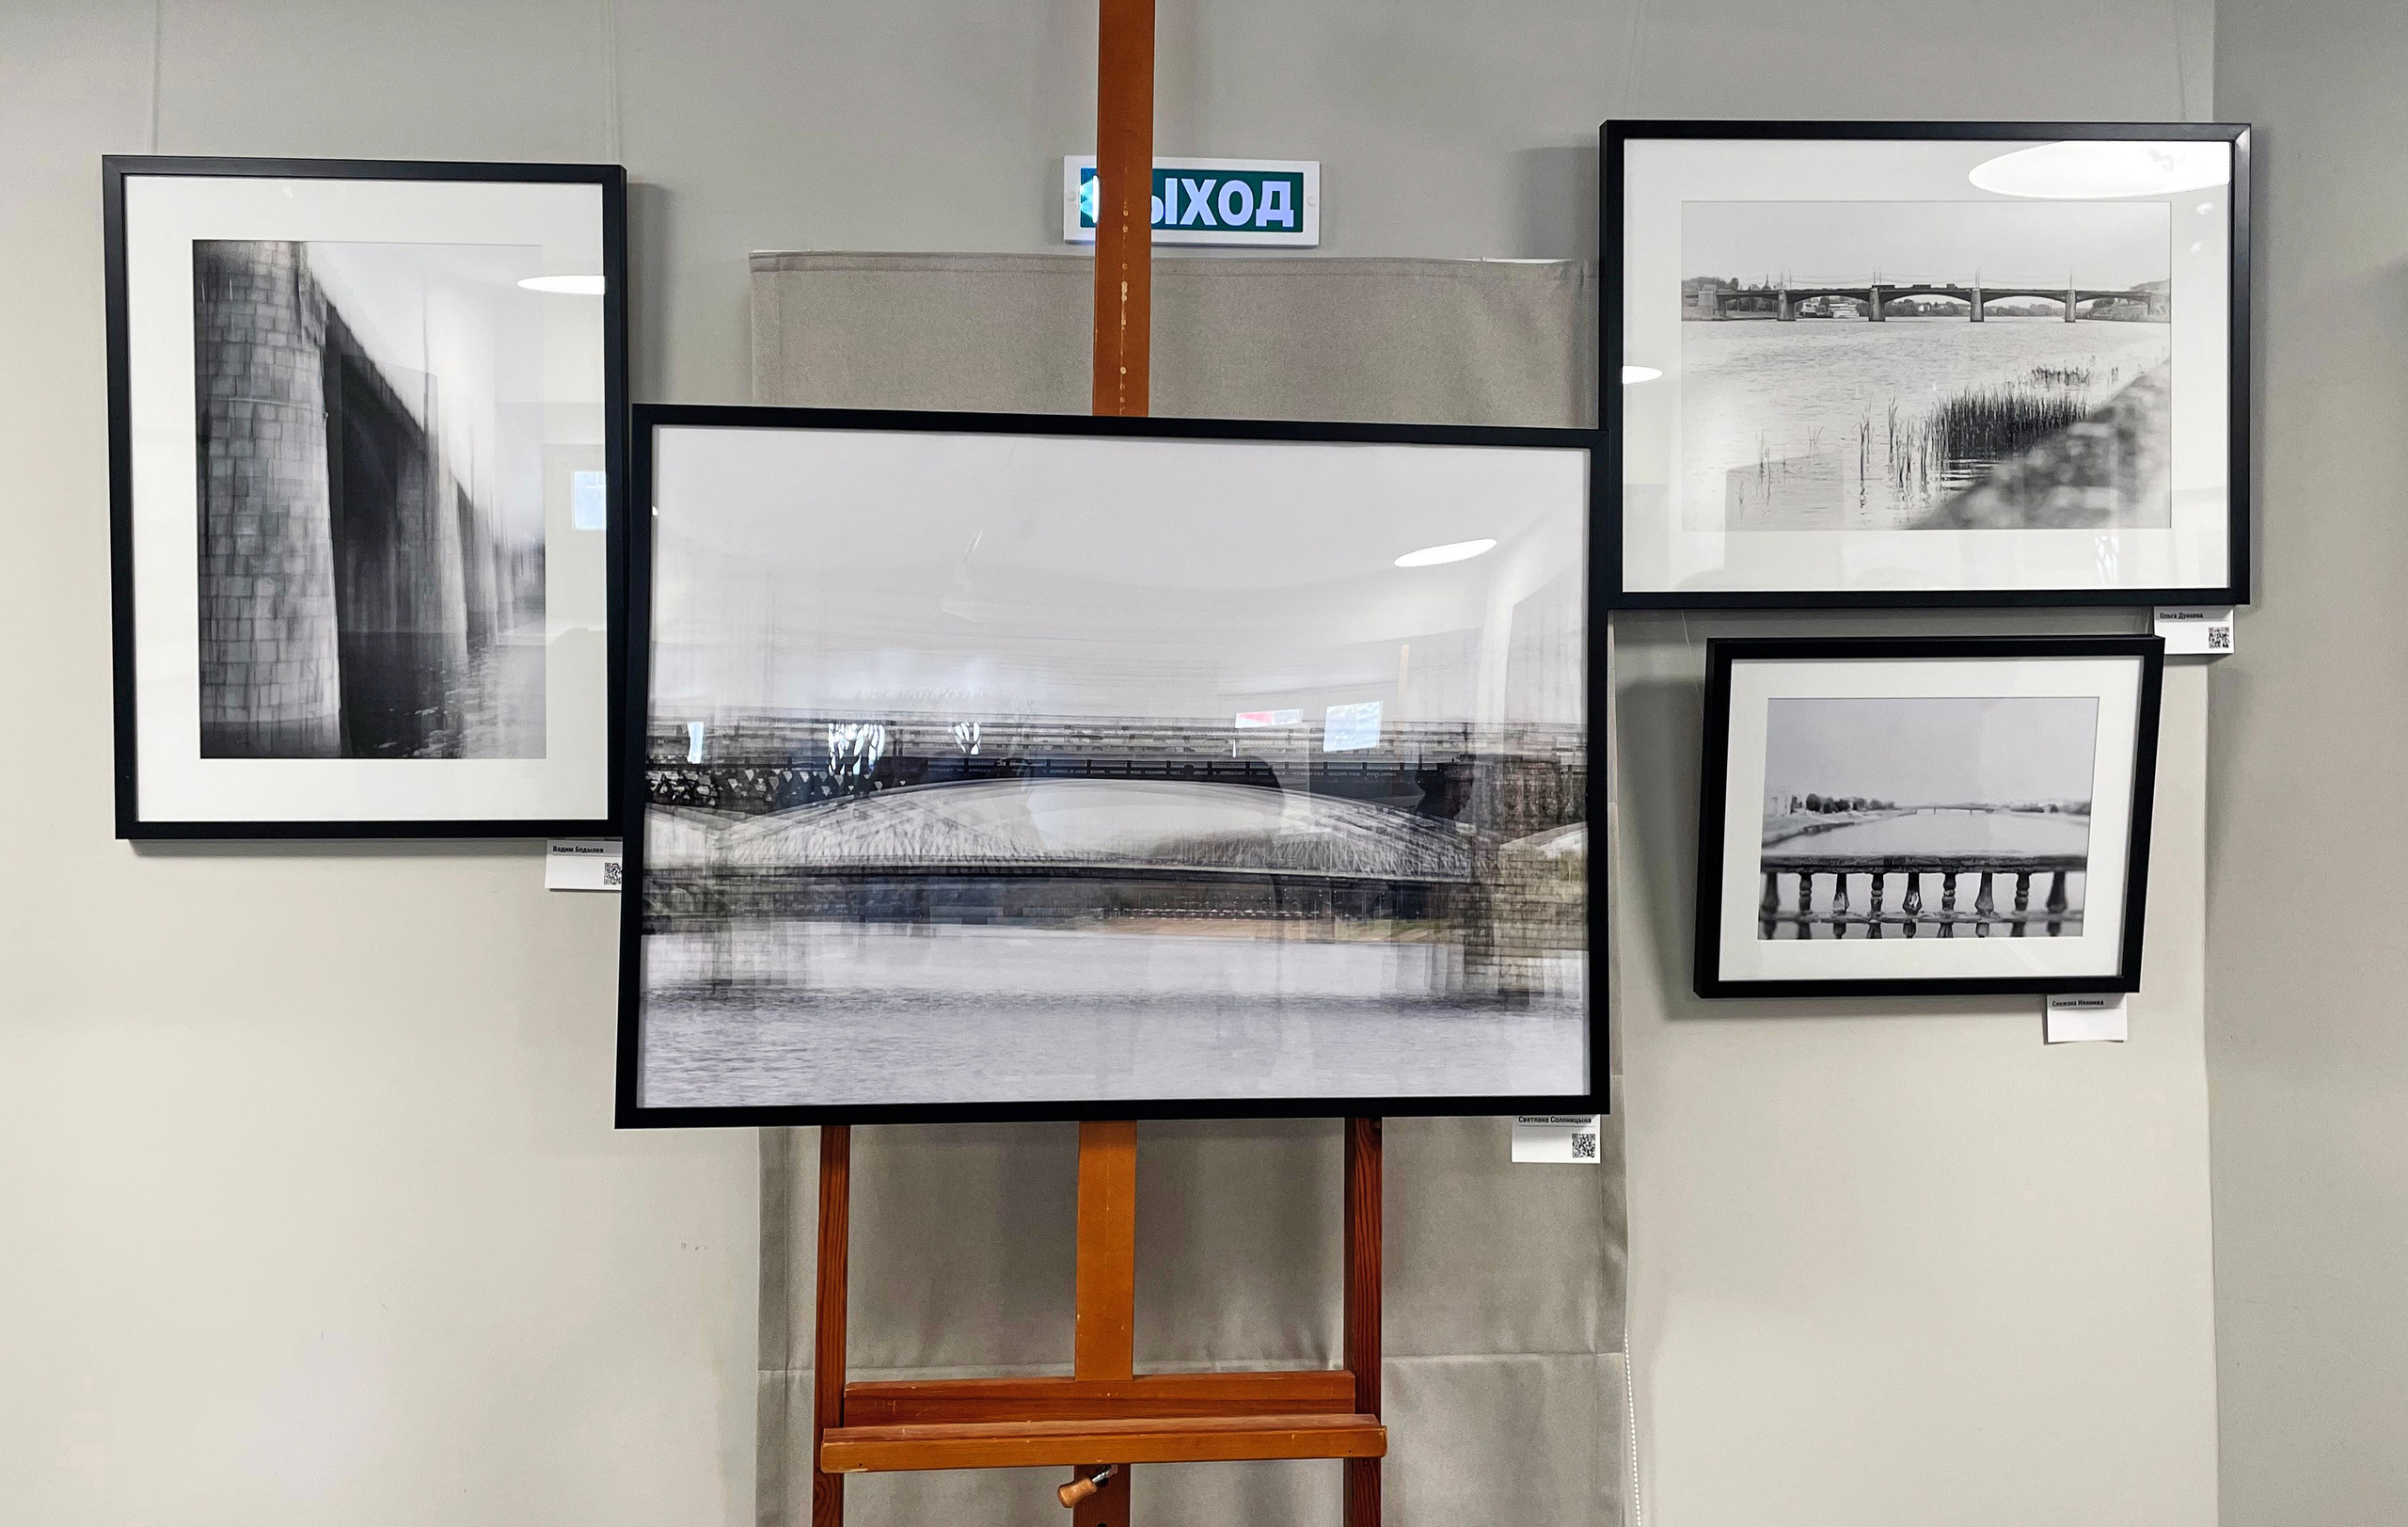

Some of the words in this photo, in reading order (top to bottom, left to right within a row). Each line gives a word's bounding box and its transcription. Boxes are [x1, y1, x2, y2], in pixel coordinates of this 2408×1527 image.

[1150, 177, 1295, 228] ЫХОД
[552, 845, 574, 853] Вадим
[1550, 1116, 1592, 1124] Солоницына
